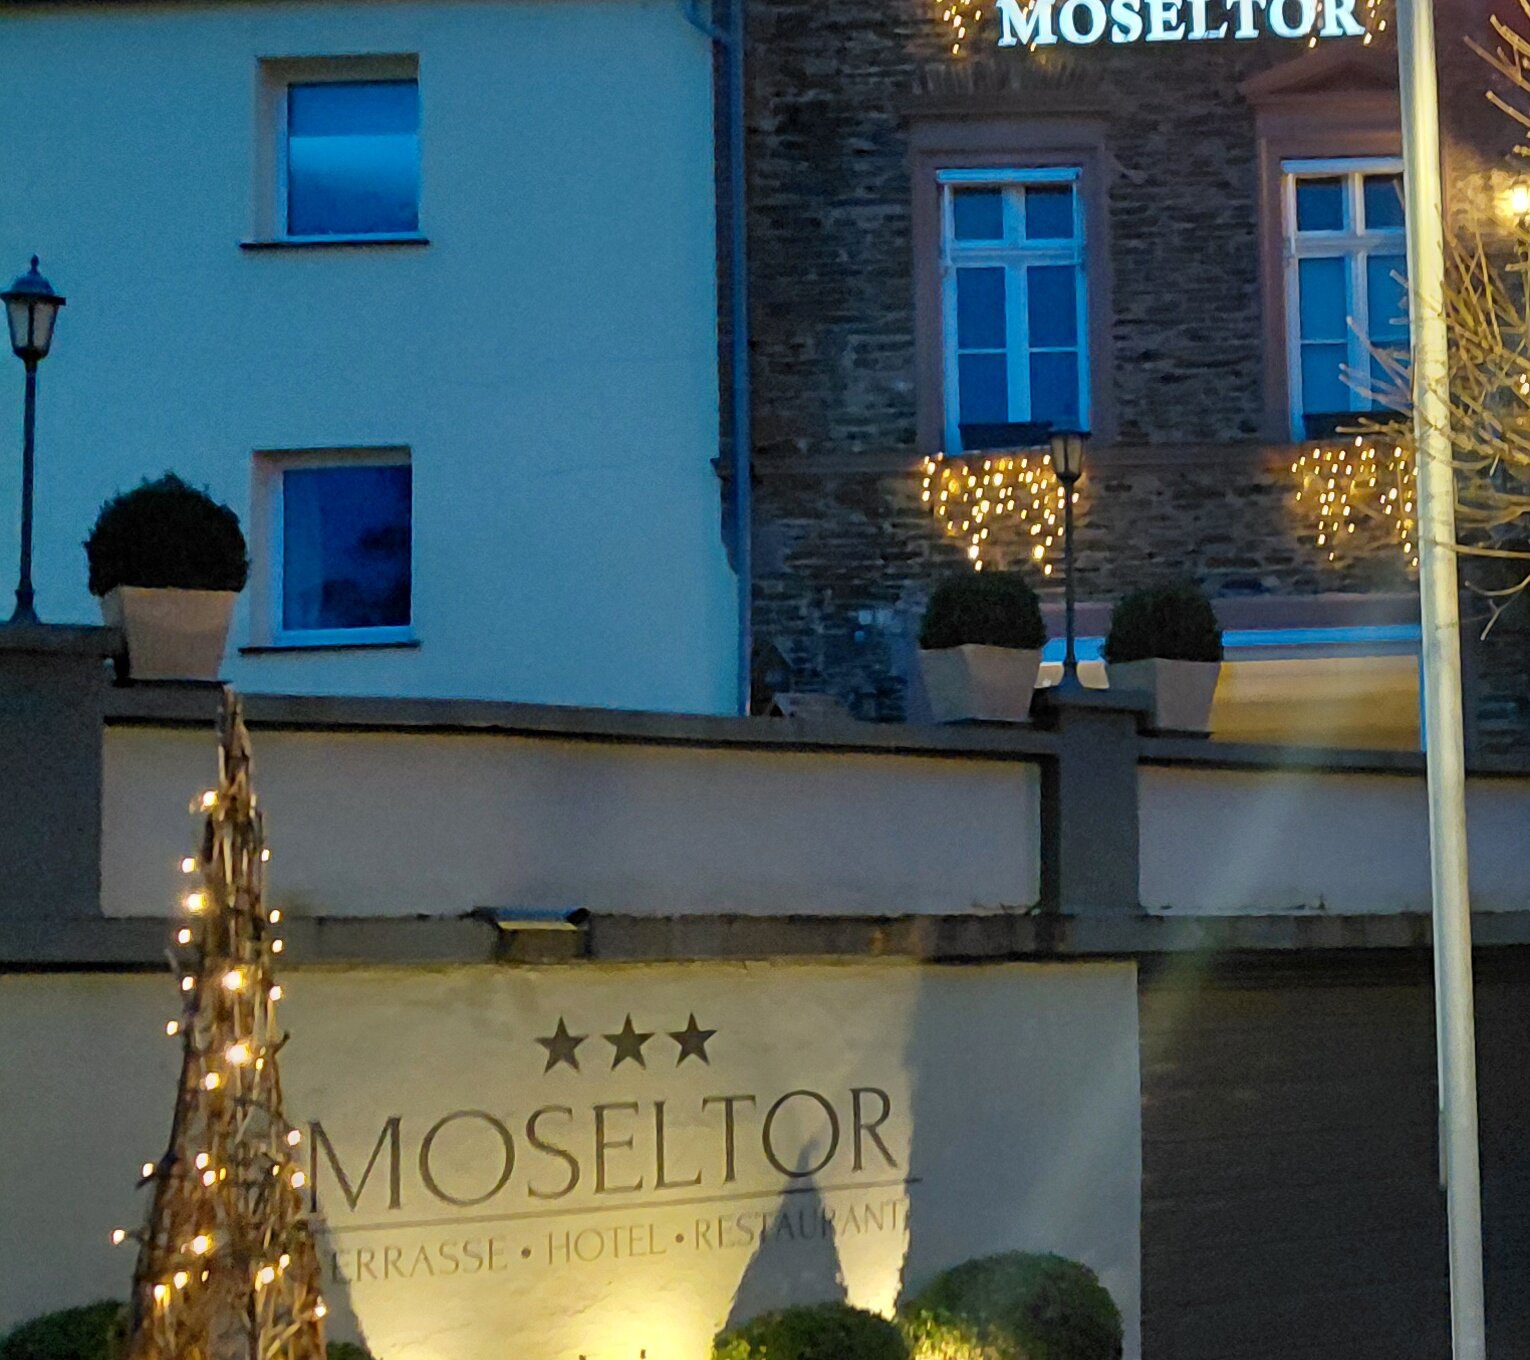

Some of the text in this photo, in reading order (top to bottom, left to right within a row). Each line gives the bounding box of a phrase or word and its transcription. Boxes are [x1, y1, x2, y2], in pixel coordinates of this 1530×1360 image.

[307, 1086, 898, 1213] MOSELTOR
[328, 1197, 906, 1283] ERRASSE HOTEL RESTAURANT
